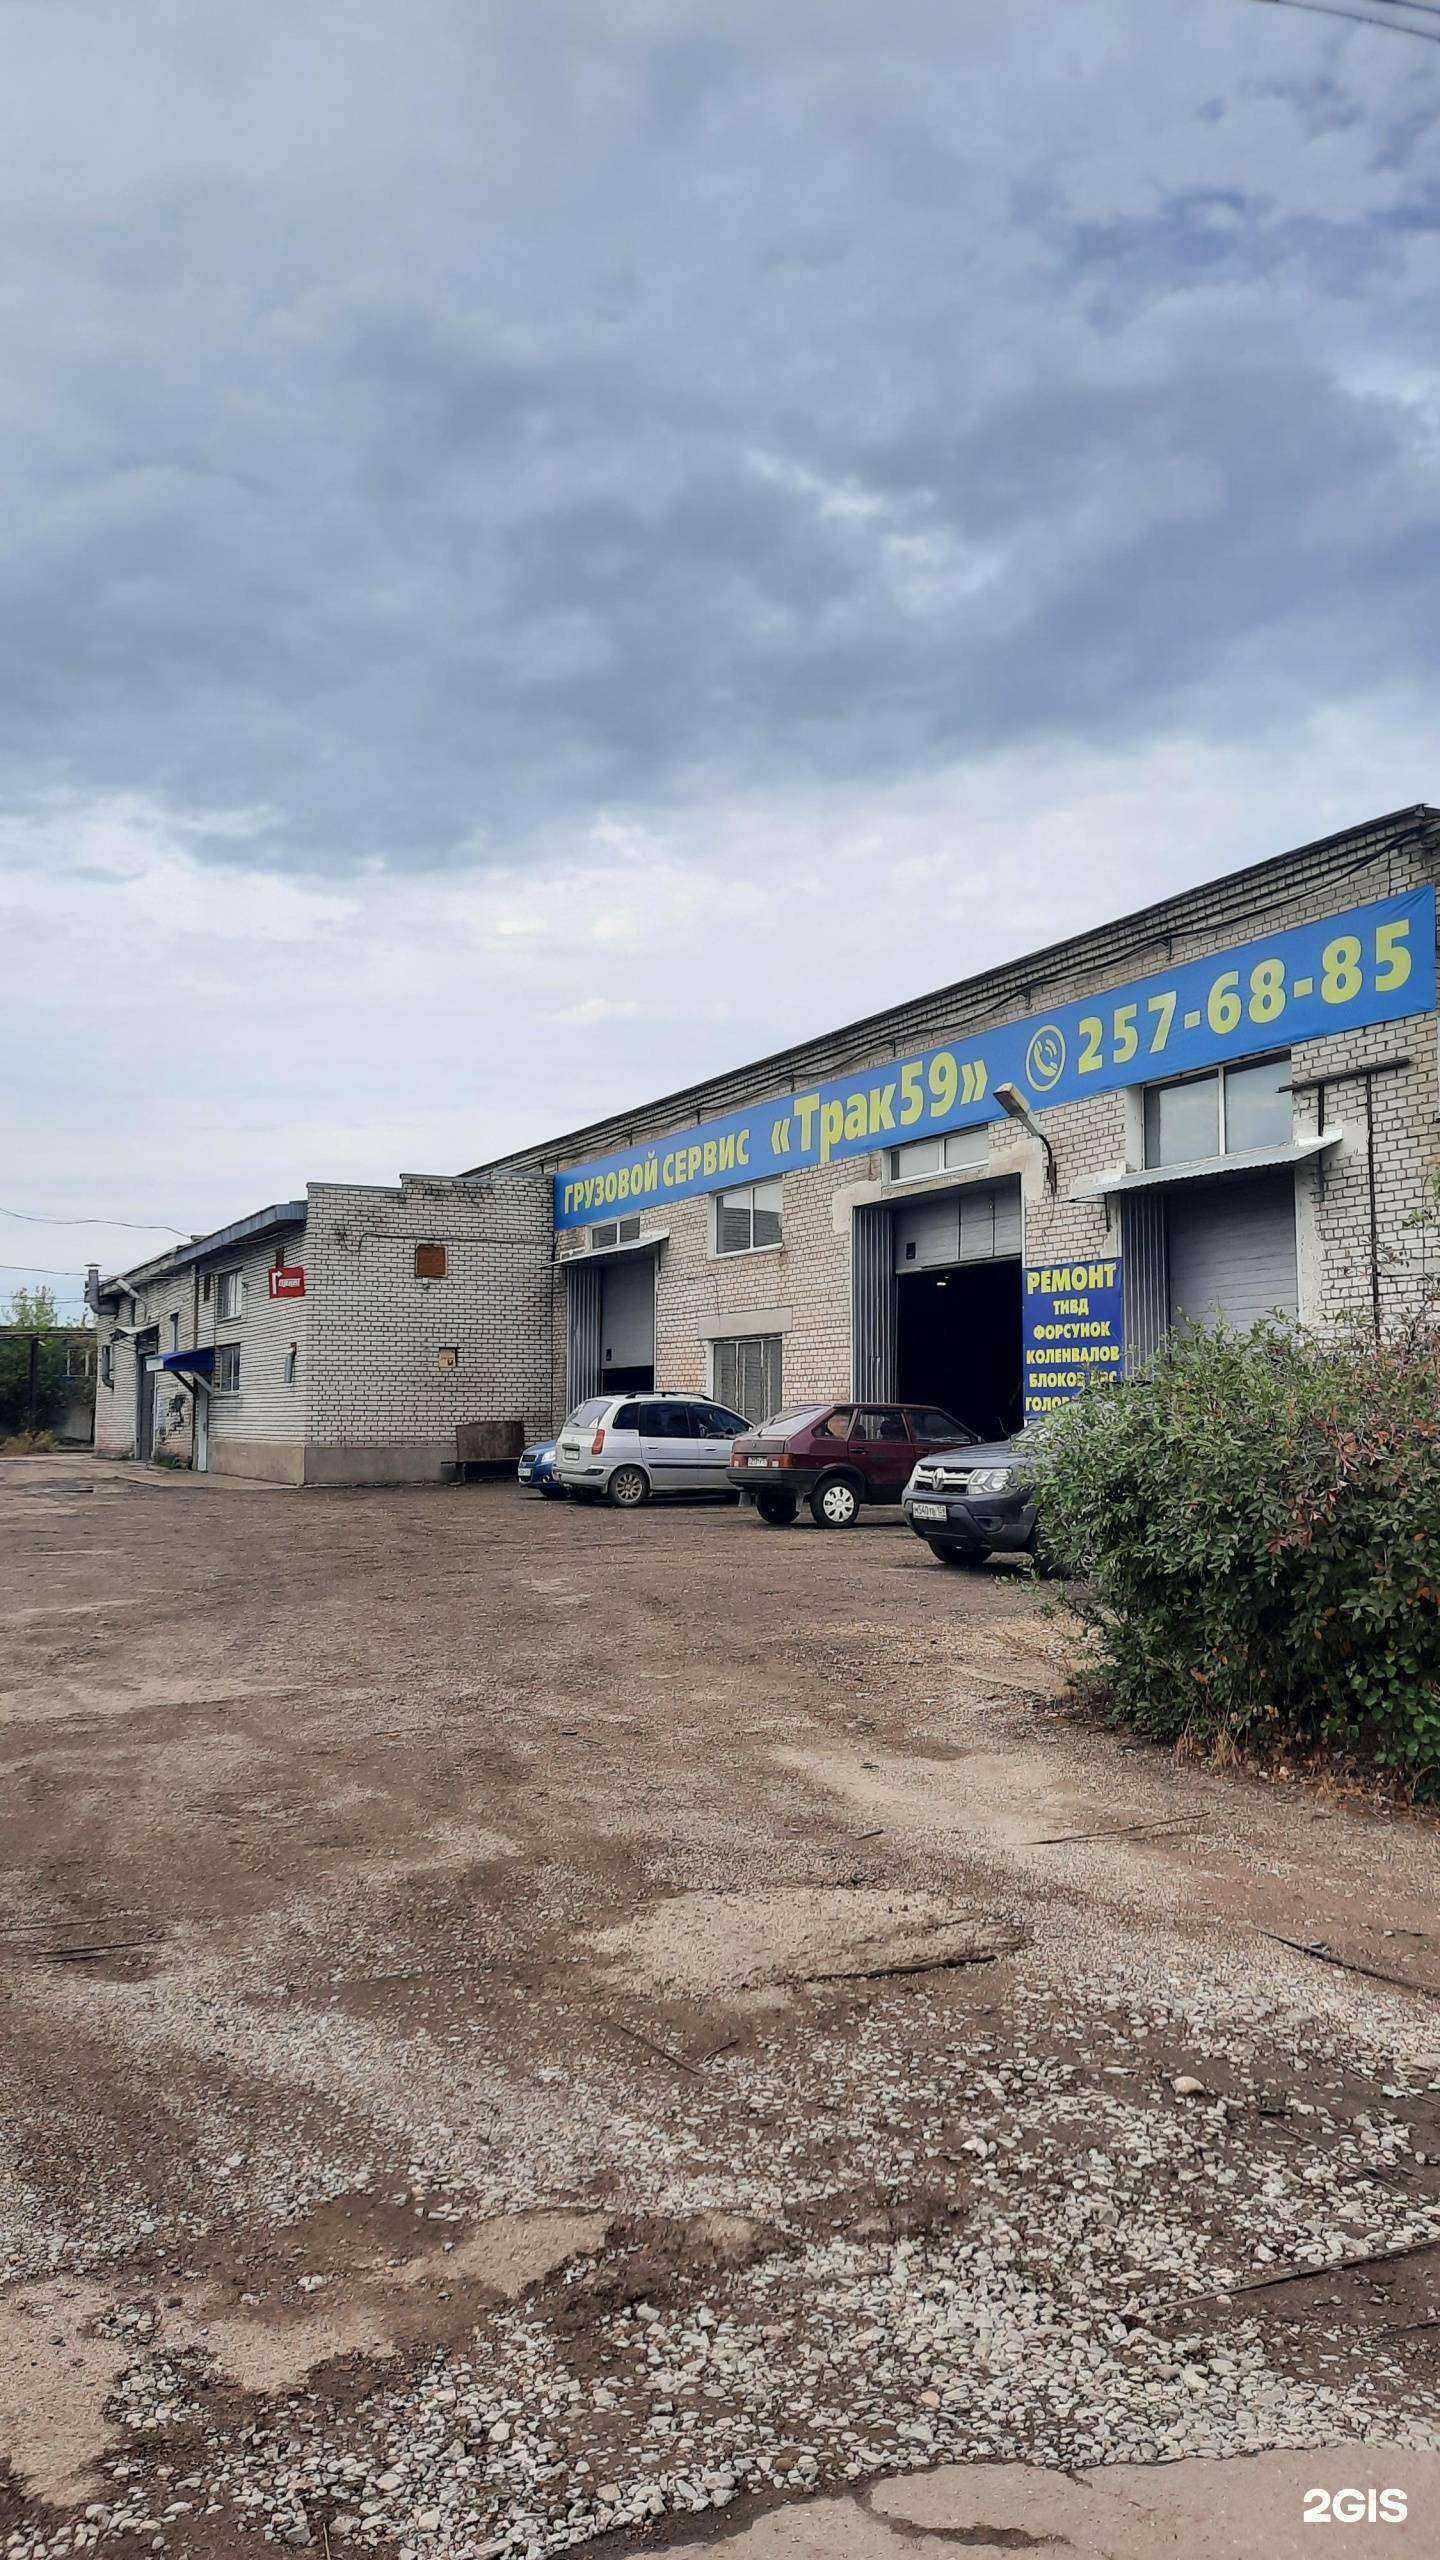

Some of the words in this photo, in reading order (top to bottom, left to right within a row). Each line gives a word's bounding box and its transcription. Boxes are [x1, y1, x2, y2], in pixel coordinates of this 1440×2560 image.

[564, 1150, 658, 1214] ГРУЗОВОЙ
[663, 1130, 749, 1187] СЕРВИС
[771, 1052, 988, 1164] «Трак59»
[1078, 919, 1412, 1074] 257-68-85
[1027, 1264, 1117, 1294] РЕМОНТ
[1033, 1321, 1111, 1341] ФОРСУНОК
[1026, 1346, 1119, 1364] КОЛЕНВАЛОВ
